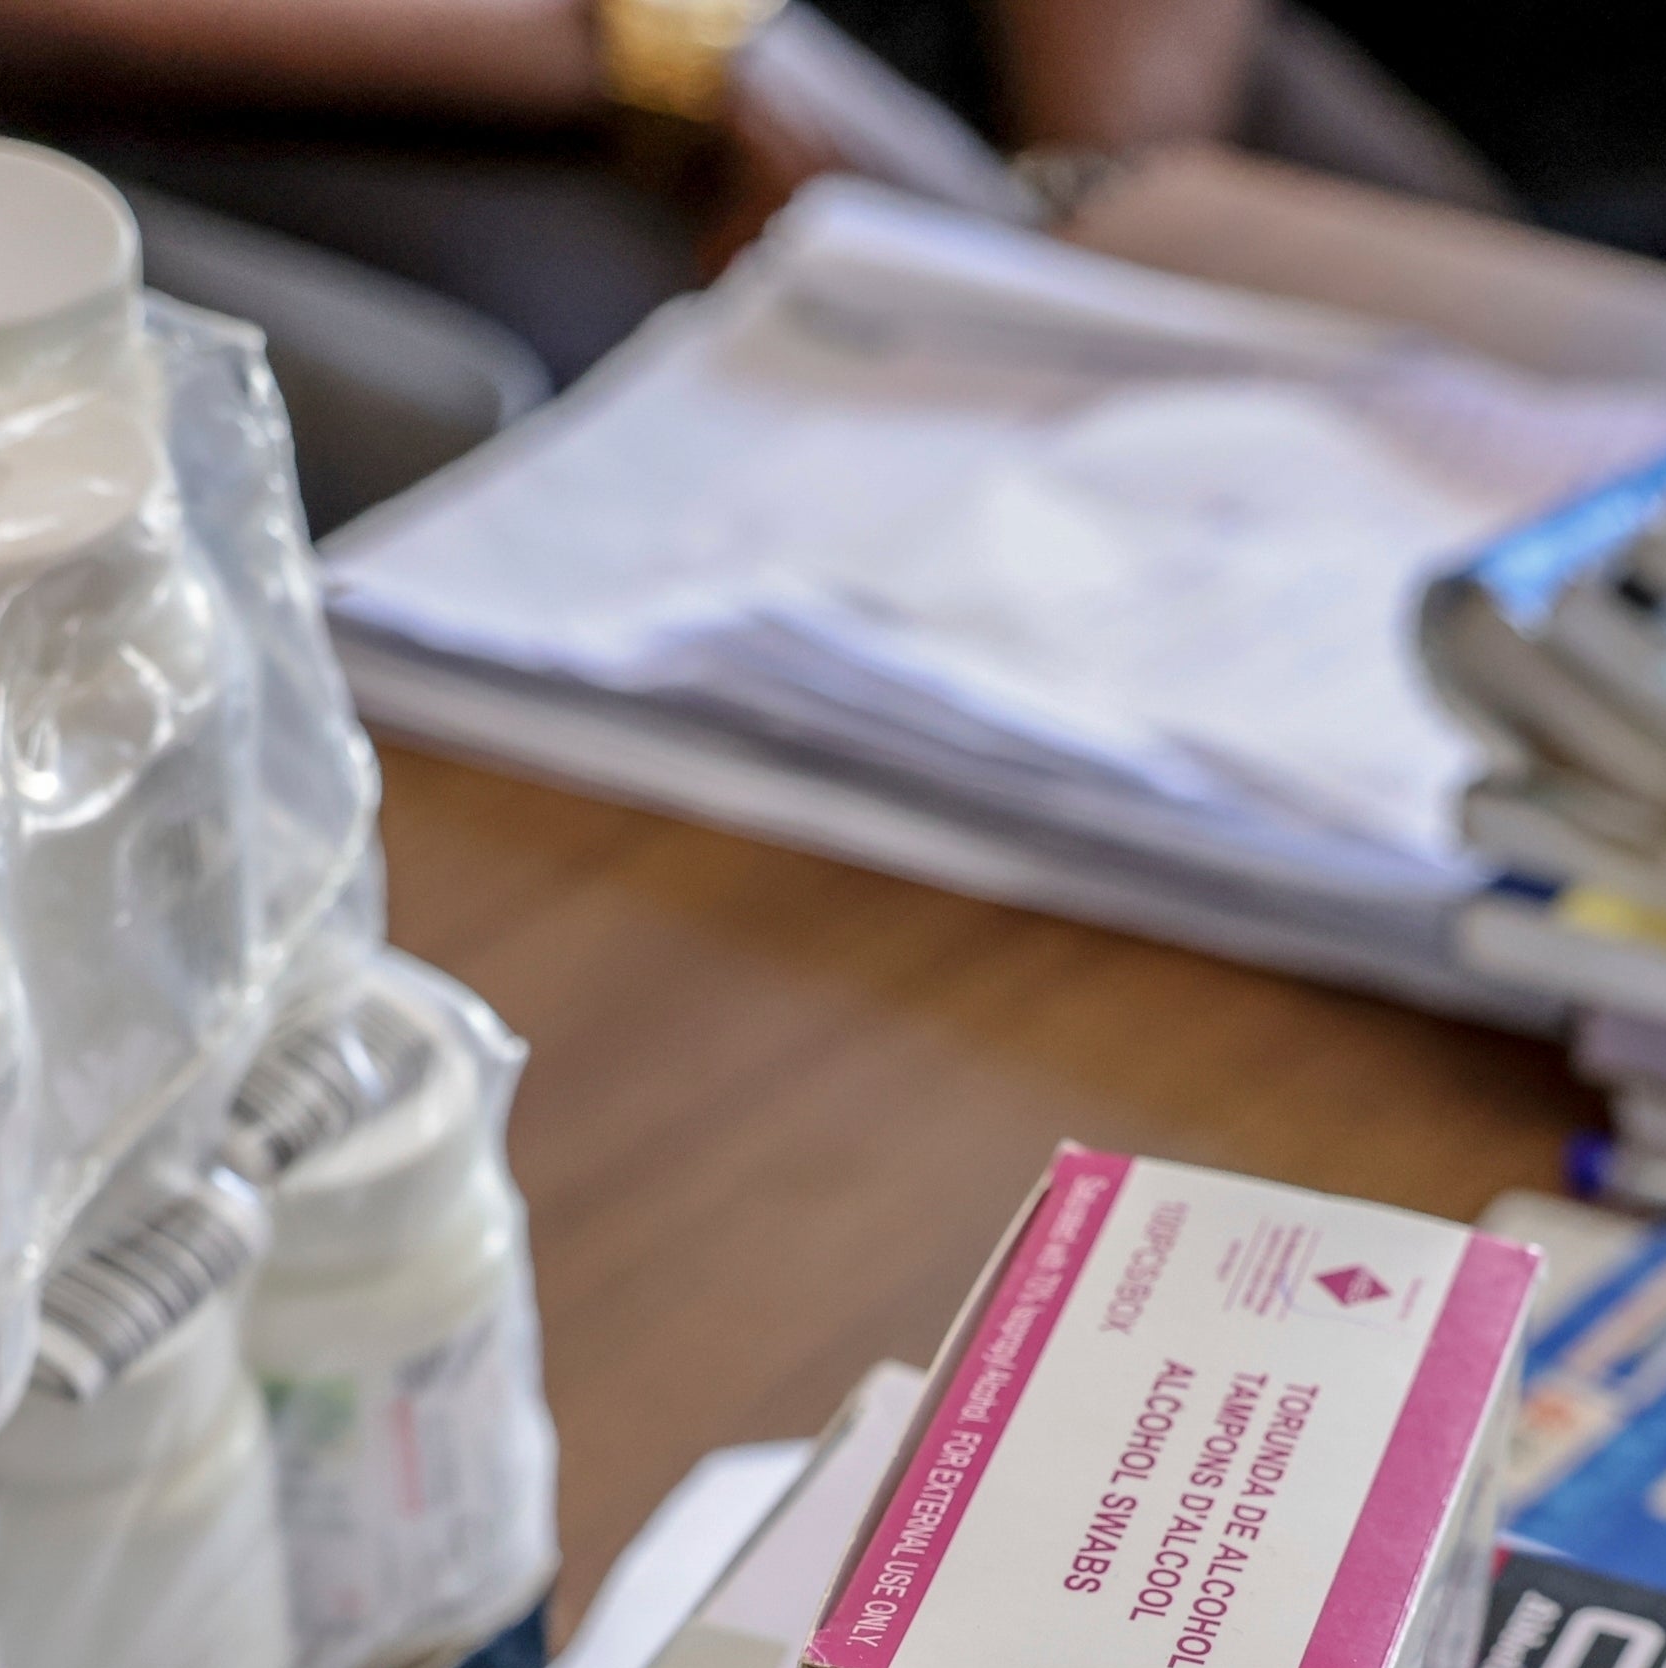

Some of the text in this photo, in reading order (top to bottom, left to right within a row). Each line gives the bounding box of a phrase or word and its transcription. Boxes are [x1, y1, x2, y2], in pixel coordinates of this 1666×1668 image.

[937, 1430, 983, 1476] FOR
[1063, 1360, 1195, 1593] ALCOHOL SWABS
[1129, 1374, 1268, 1621] TAMPONS D'ALCOOL
[890, 1468, 964, 1567] EXTERNAL
[1167, 1385, 1319, 1668] TORUNDA DE ALCOHOL
[846, 1600, 898, 1648] ONLY.
[872, 1553, 918, 1598] USE
